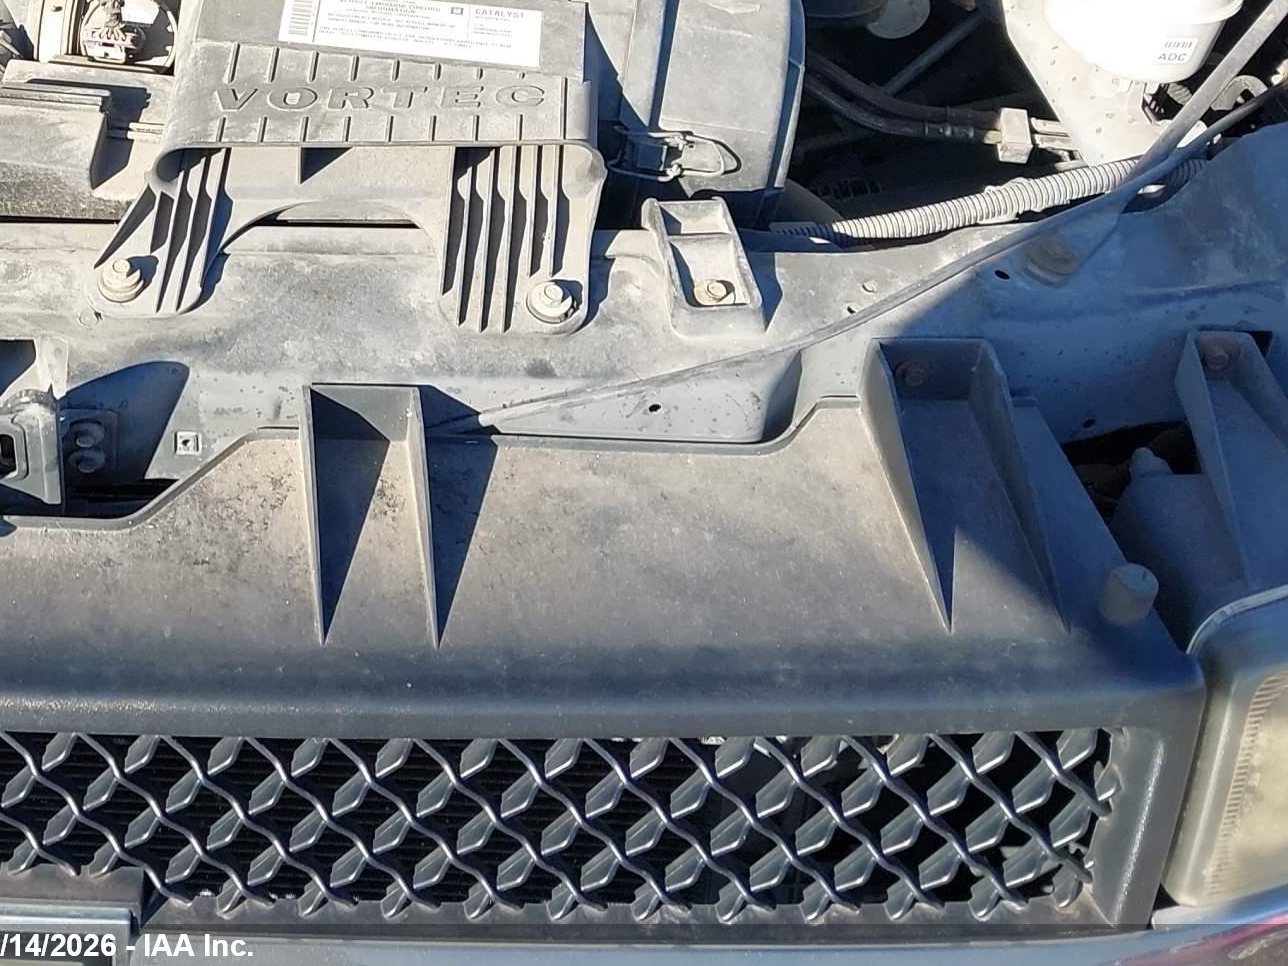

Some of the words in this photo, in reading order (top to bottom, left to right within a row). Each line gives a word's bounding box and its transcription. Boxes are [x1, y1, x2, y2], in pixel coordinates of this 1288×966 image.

[475, 8, 524, 19] CATALYST
[1157, 52, 1188, 62] ADC
[212, 84, 546, 112] VORTEC
